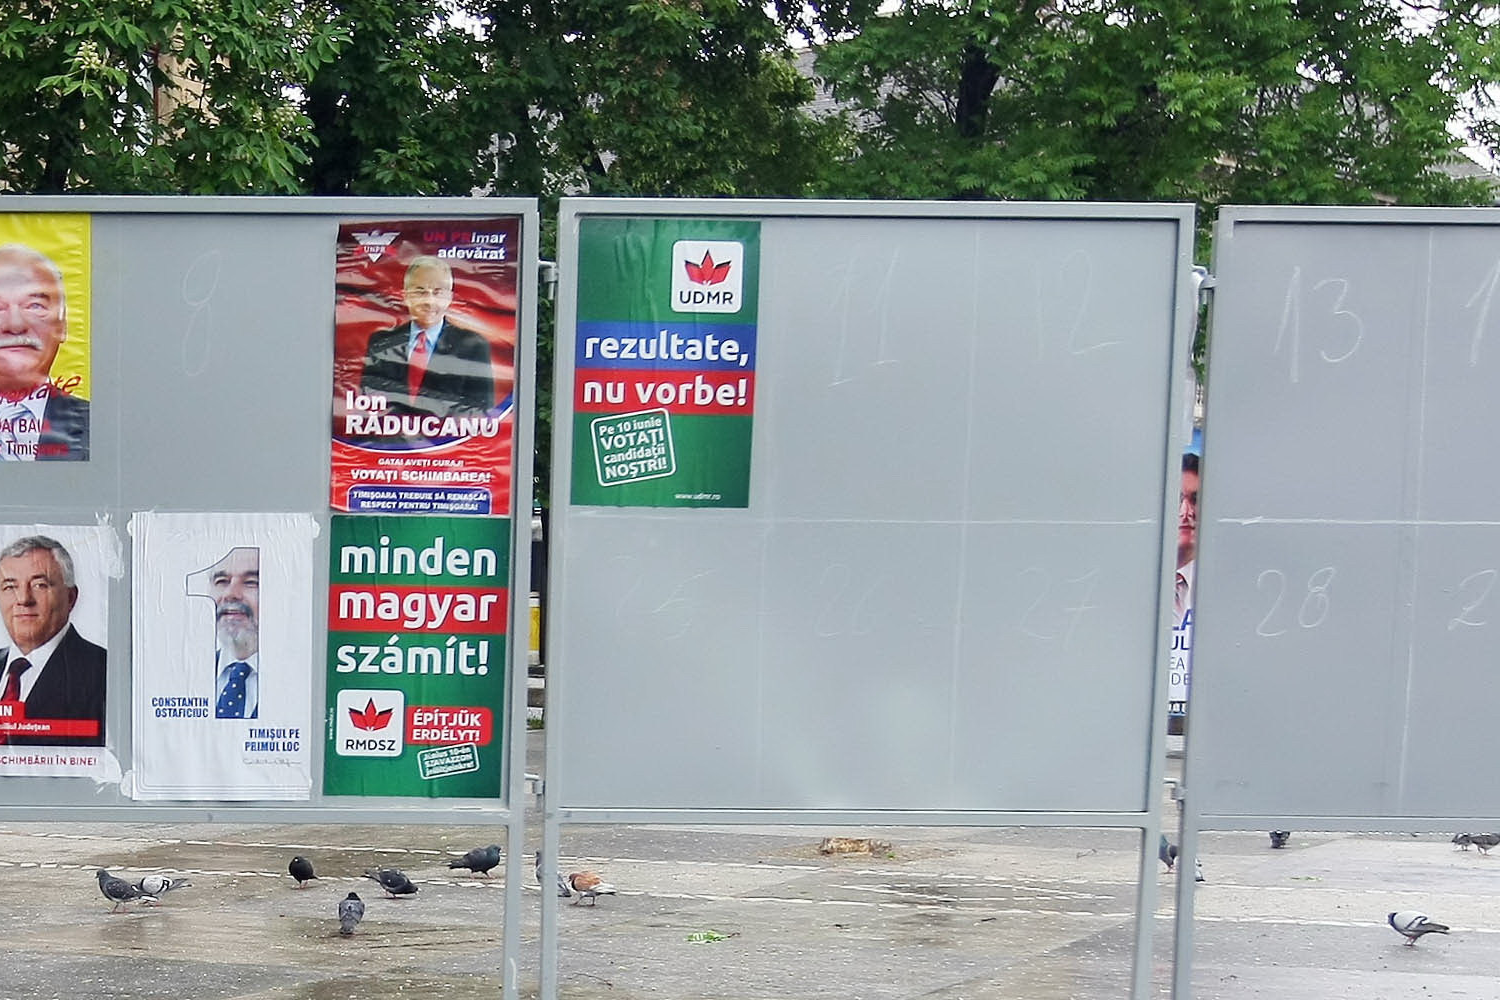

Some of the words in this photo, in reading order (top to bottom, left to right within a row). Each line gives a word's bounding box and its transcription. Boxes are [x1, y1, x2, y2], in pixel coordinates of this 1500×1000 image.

[423, 231, 446, 242] UN
[363, 245, 386, 253] UNPR
[437, 246, 506, 260] adevărat
[679, 291, 734, 305] UDMR
[1273, 266, 1364, 383] 13
[585, 329, 749, 367] rezultate,
[583, 381, 625, 404] nu
[635, 375, 747, 406] vorbe!
[345, 390, 387, 411] Ion
[345, 411, 500, 438] RĂDUCANU
[599, 425, 615, 436] Pe
[617, 421, 631, 432] 10
[633, 416, 662, 430] iunie
[600, 427, 665, 450] VOTAȚI
[603, 443, 666, 465] candidații
[605, 456, 668, 479] NOȘTRI!
[350, 469, 398, 483] VOTAȚI
[401, 470, 492, 483] SCHIMBAREA!
[353, 491, 397, 500] TIMIȘOARA
[674, 492, 721, 501] www.udmr.ro
[360, 501, 397, 509] RESPECT
[398, 502, 431, 510] PENTRU
[340, 535, 498, 577] minden
[1256, 565, 1337, 637] 28
[338, 591, 498, 630] magyar
[336, 634, 490, 676] számít!
[151, 697, 209, 708] CONSTANTIN
[155, 707, 209, 718] OSTAFICIUC
[249, 728, 287, 740] TIMIȘUL
[289, 728, 300, 739] PE
[412, 727, 480, 742] ERDÉLYT!
[244, 741, 280, 752] PRIMUL
[282, 741, 300, 752] LOC
[346, 739, 396, 751] RMDSZ
[56, 754, 67, 766] ÎN
[70, 757, 97, 766] BINE!
